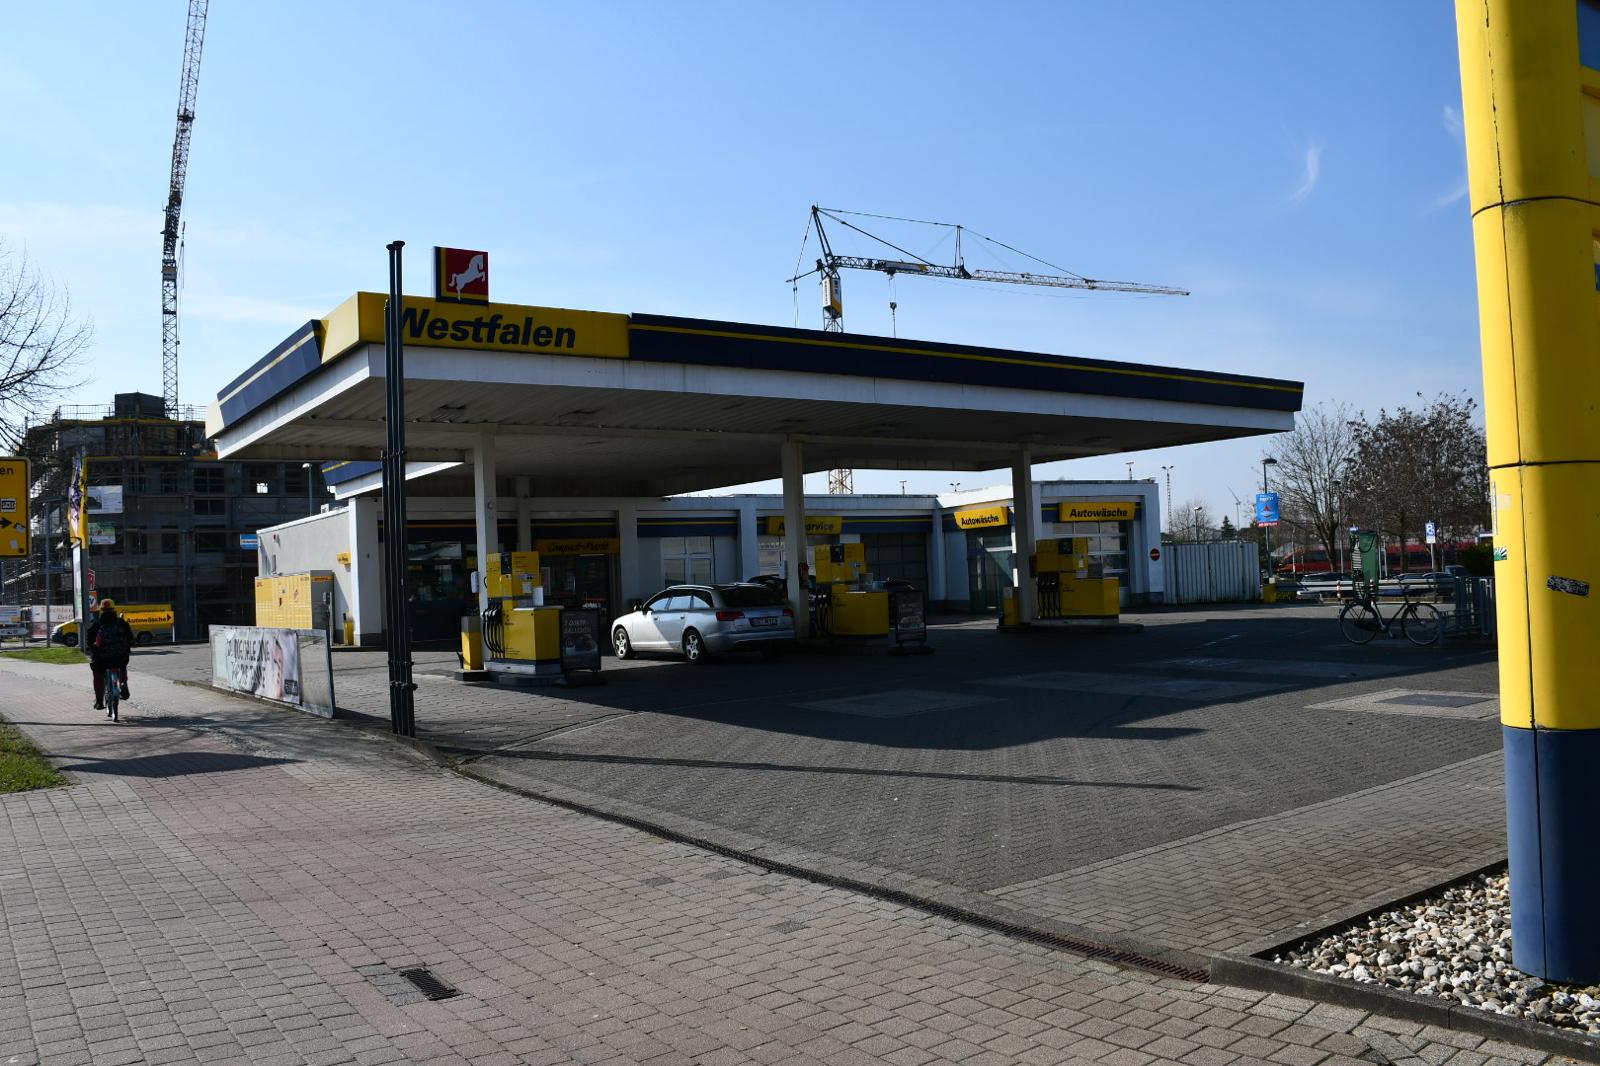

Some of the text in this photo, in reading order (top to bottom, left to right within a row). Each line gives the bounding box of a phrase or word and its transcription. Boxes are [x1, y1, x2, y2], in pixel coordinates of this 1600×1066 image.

[402, 307, 576, 348] Westfalen
[0, 465, 14, 475] en
[1069, 507, 1129, 519] Autowäsche
[961, 514, 999, 526] Autowäsche
